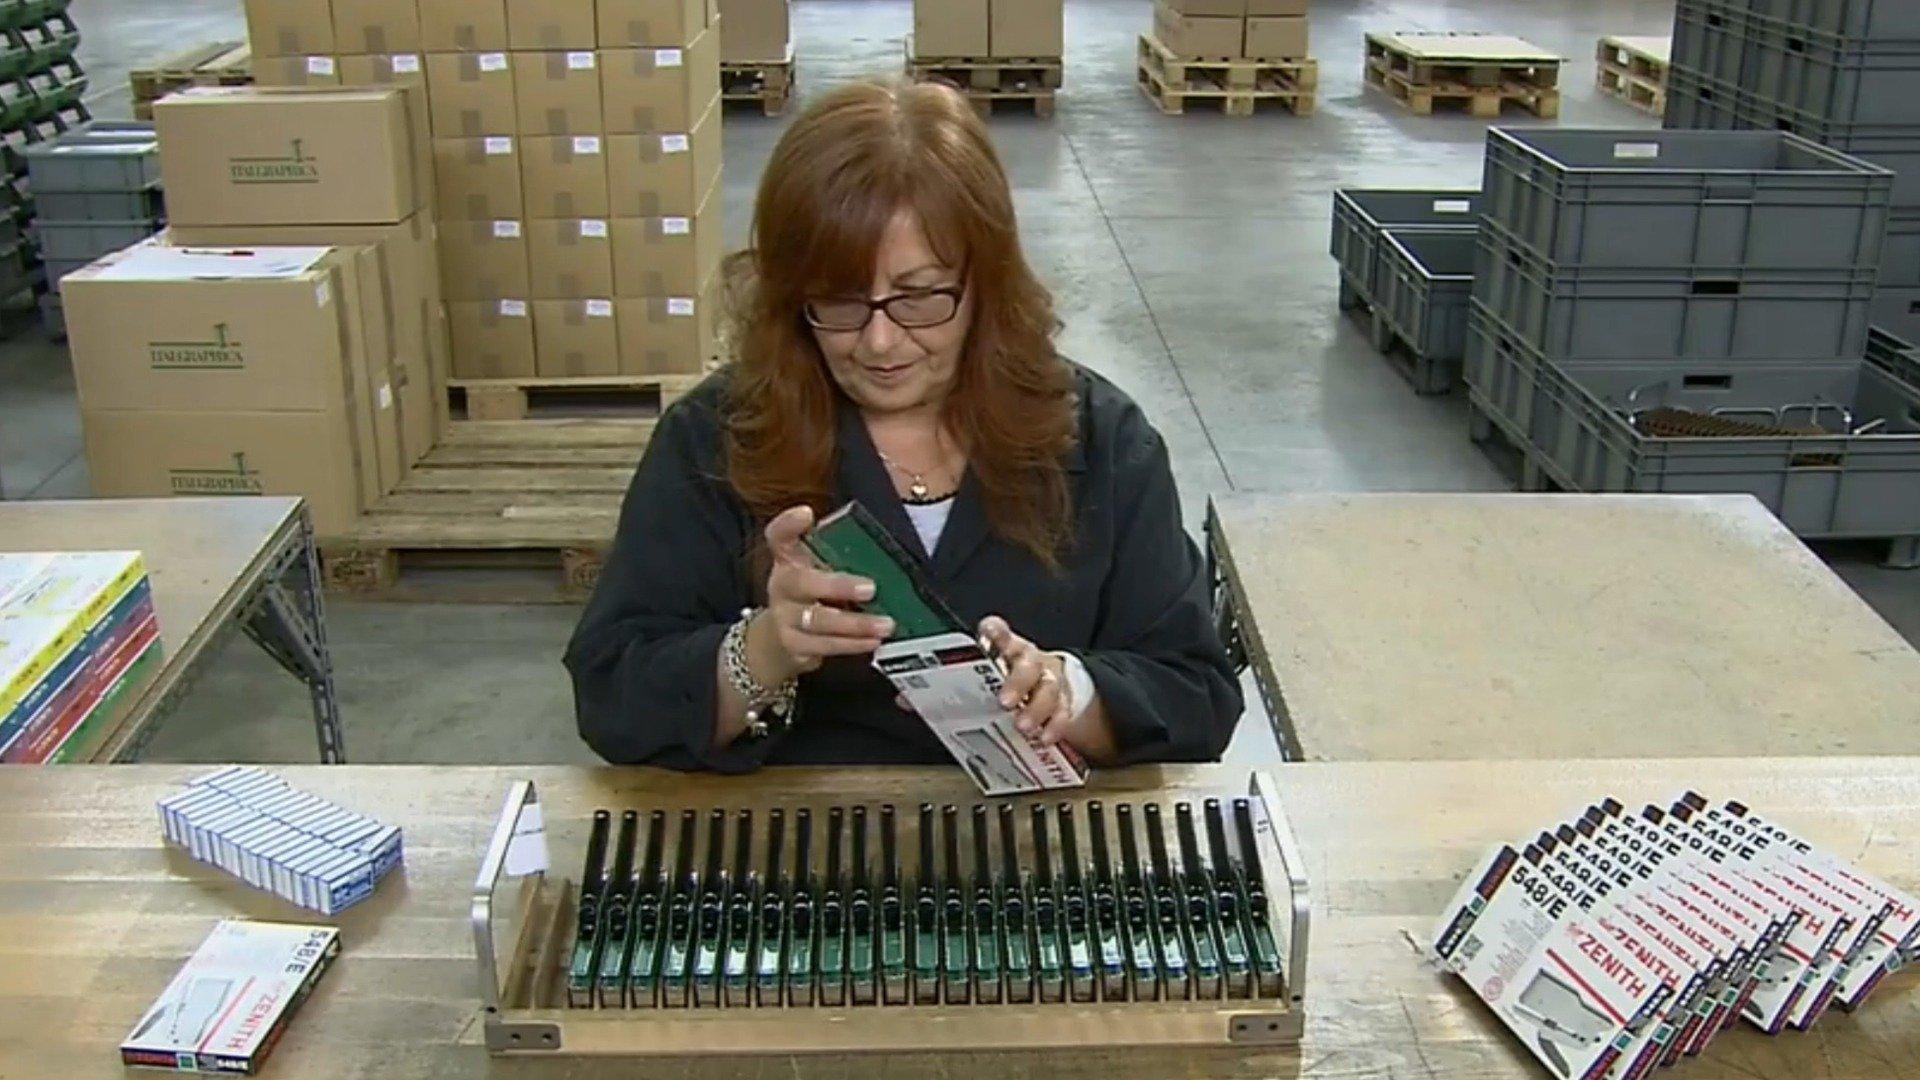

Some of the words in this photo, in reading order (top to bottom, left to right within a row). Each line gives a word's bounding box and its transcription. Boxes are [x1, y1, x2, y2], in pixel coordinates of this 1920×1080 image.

[1511, 864, 1568, 920] 548/E
[285, 930, 330, 975] 548/E
[1578, 932, 1647, 999] ZENITH
[225, 992, 280, 1049] ZENITH
